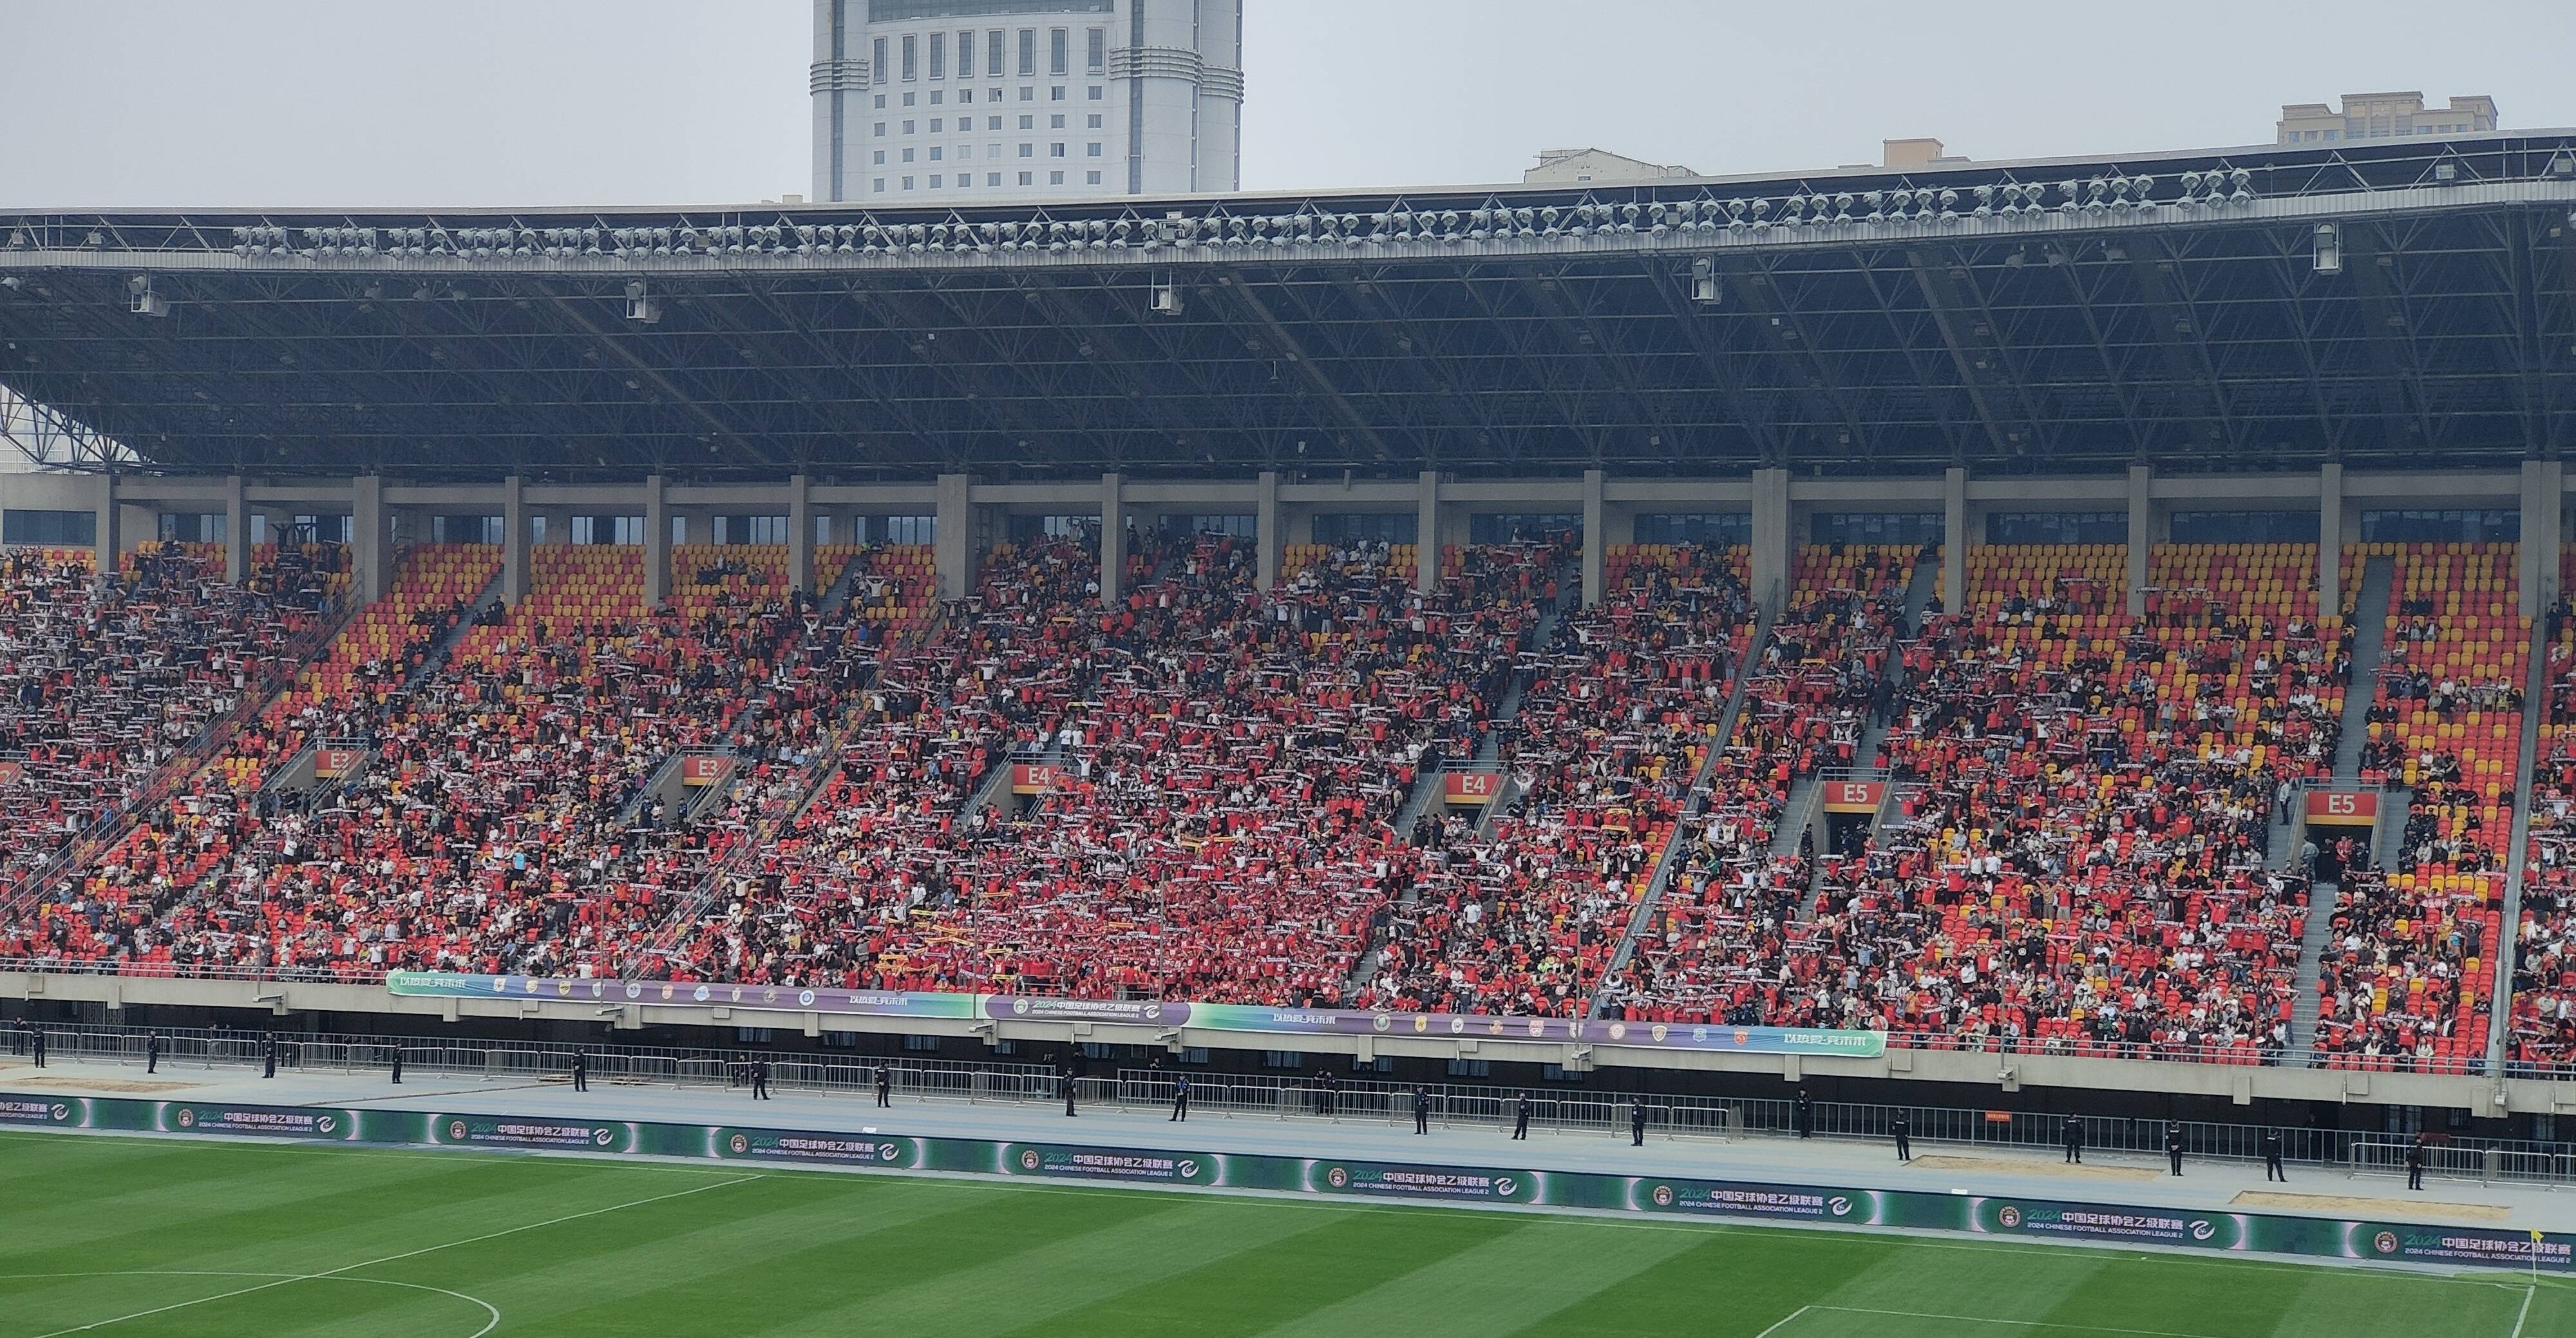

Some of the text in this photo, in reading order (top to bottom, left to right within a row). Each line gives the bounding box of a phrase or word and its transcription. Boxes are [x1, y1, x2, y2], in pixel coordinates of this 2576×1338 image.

[331, 752, 348, 768] E3
[699, 760, 717, 776] E3
[1029, 767, 1050, 784] E4
[1463, 776, 1486, 794] E4
[1844, 784, 1868, 802] E5
[2329, 795, 2355, 813] E5
[1721, 1203, 1753, 1211] FOOTBALL
[1754, 1205, 1794, 1213] ASSOCIATION
[2045, 1223, 2072, 1232] CHINESE
[2073, 1225, 2107, 1234] FOOTBALL
[2108, 1227, 2151, 1236] ASSOCIATION
[2152, 1230, 2177, 1238] LEAGUE
[2454, 1250, 2490, 1259] FOOTBALL
